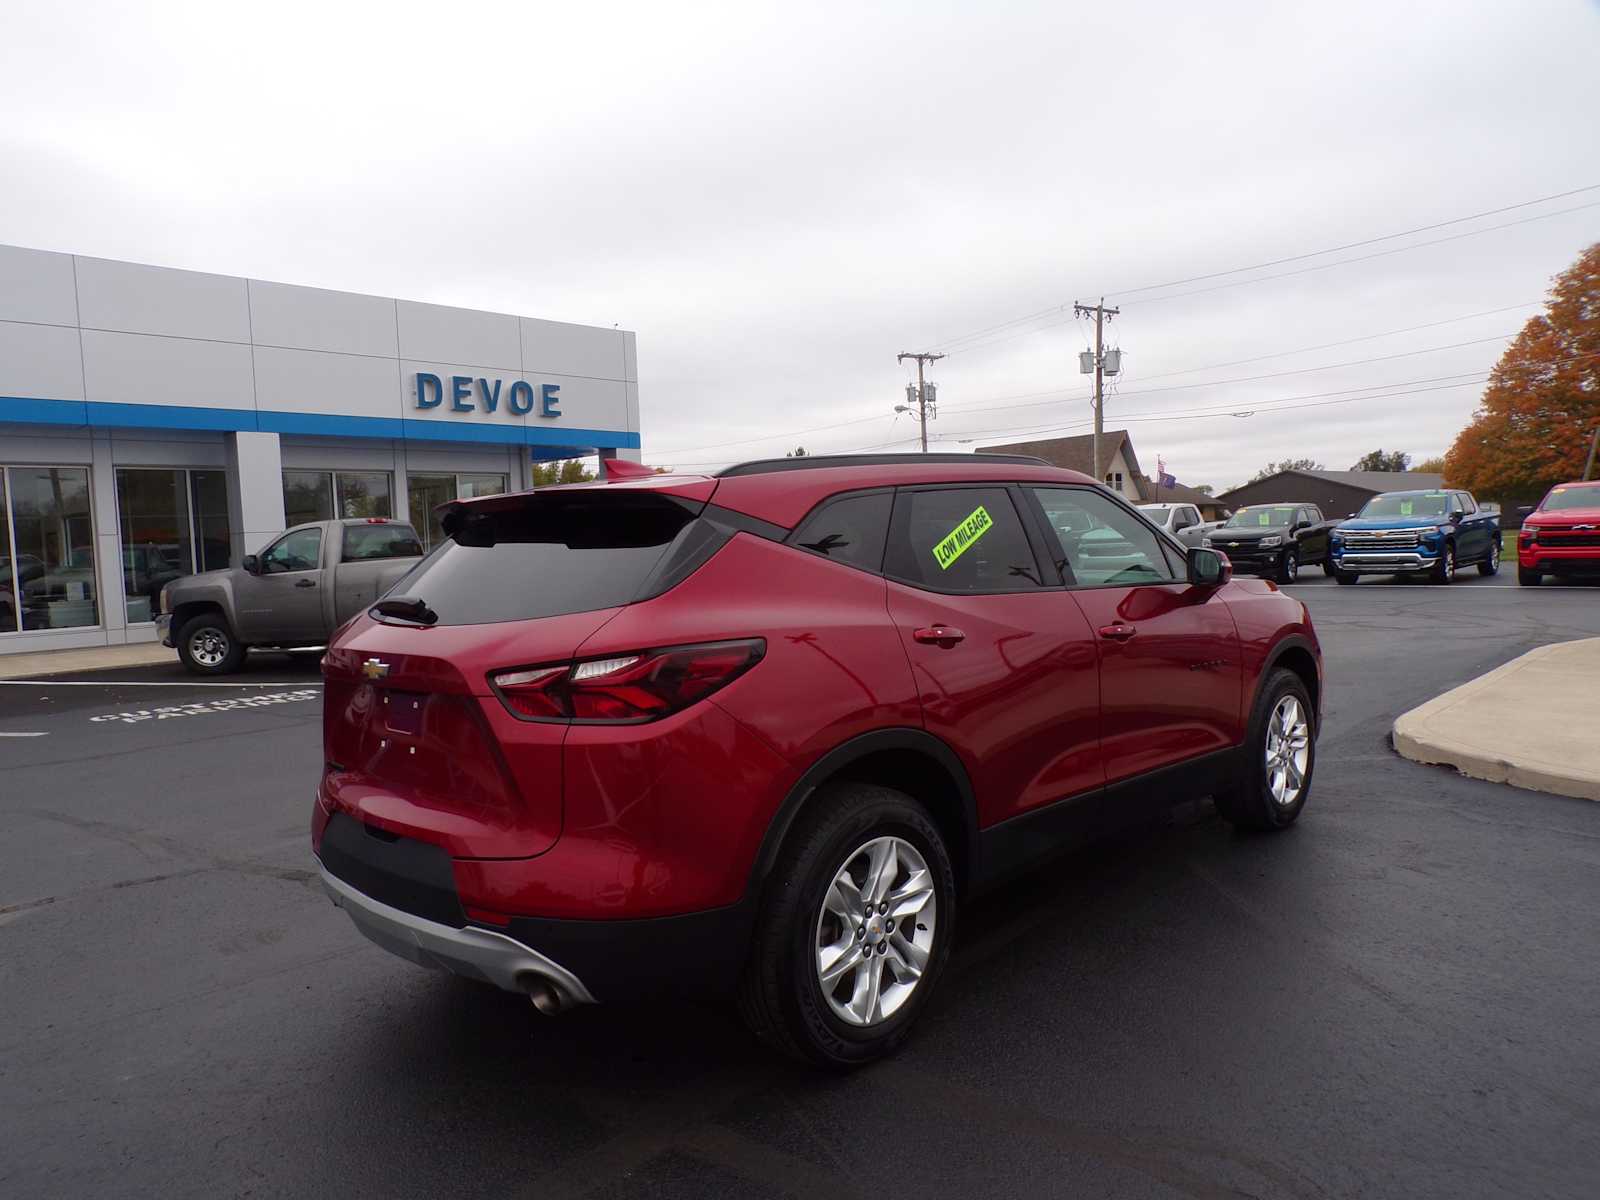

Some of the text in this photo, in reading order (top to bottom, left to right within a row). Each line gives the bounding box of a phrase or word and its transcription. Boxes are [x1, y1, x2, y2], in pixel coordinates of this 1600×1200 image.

[415, 372, 562, 418] DEVOE
[937, 510, 989, 564] LOW MILEAGE
[89, 689, 321, 722] CUSTOMER
[121, 695, 316, 723] PARKING
